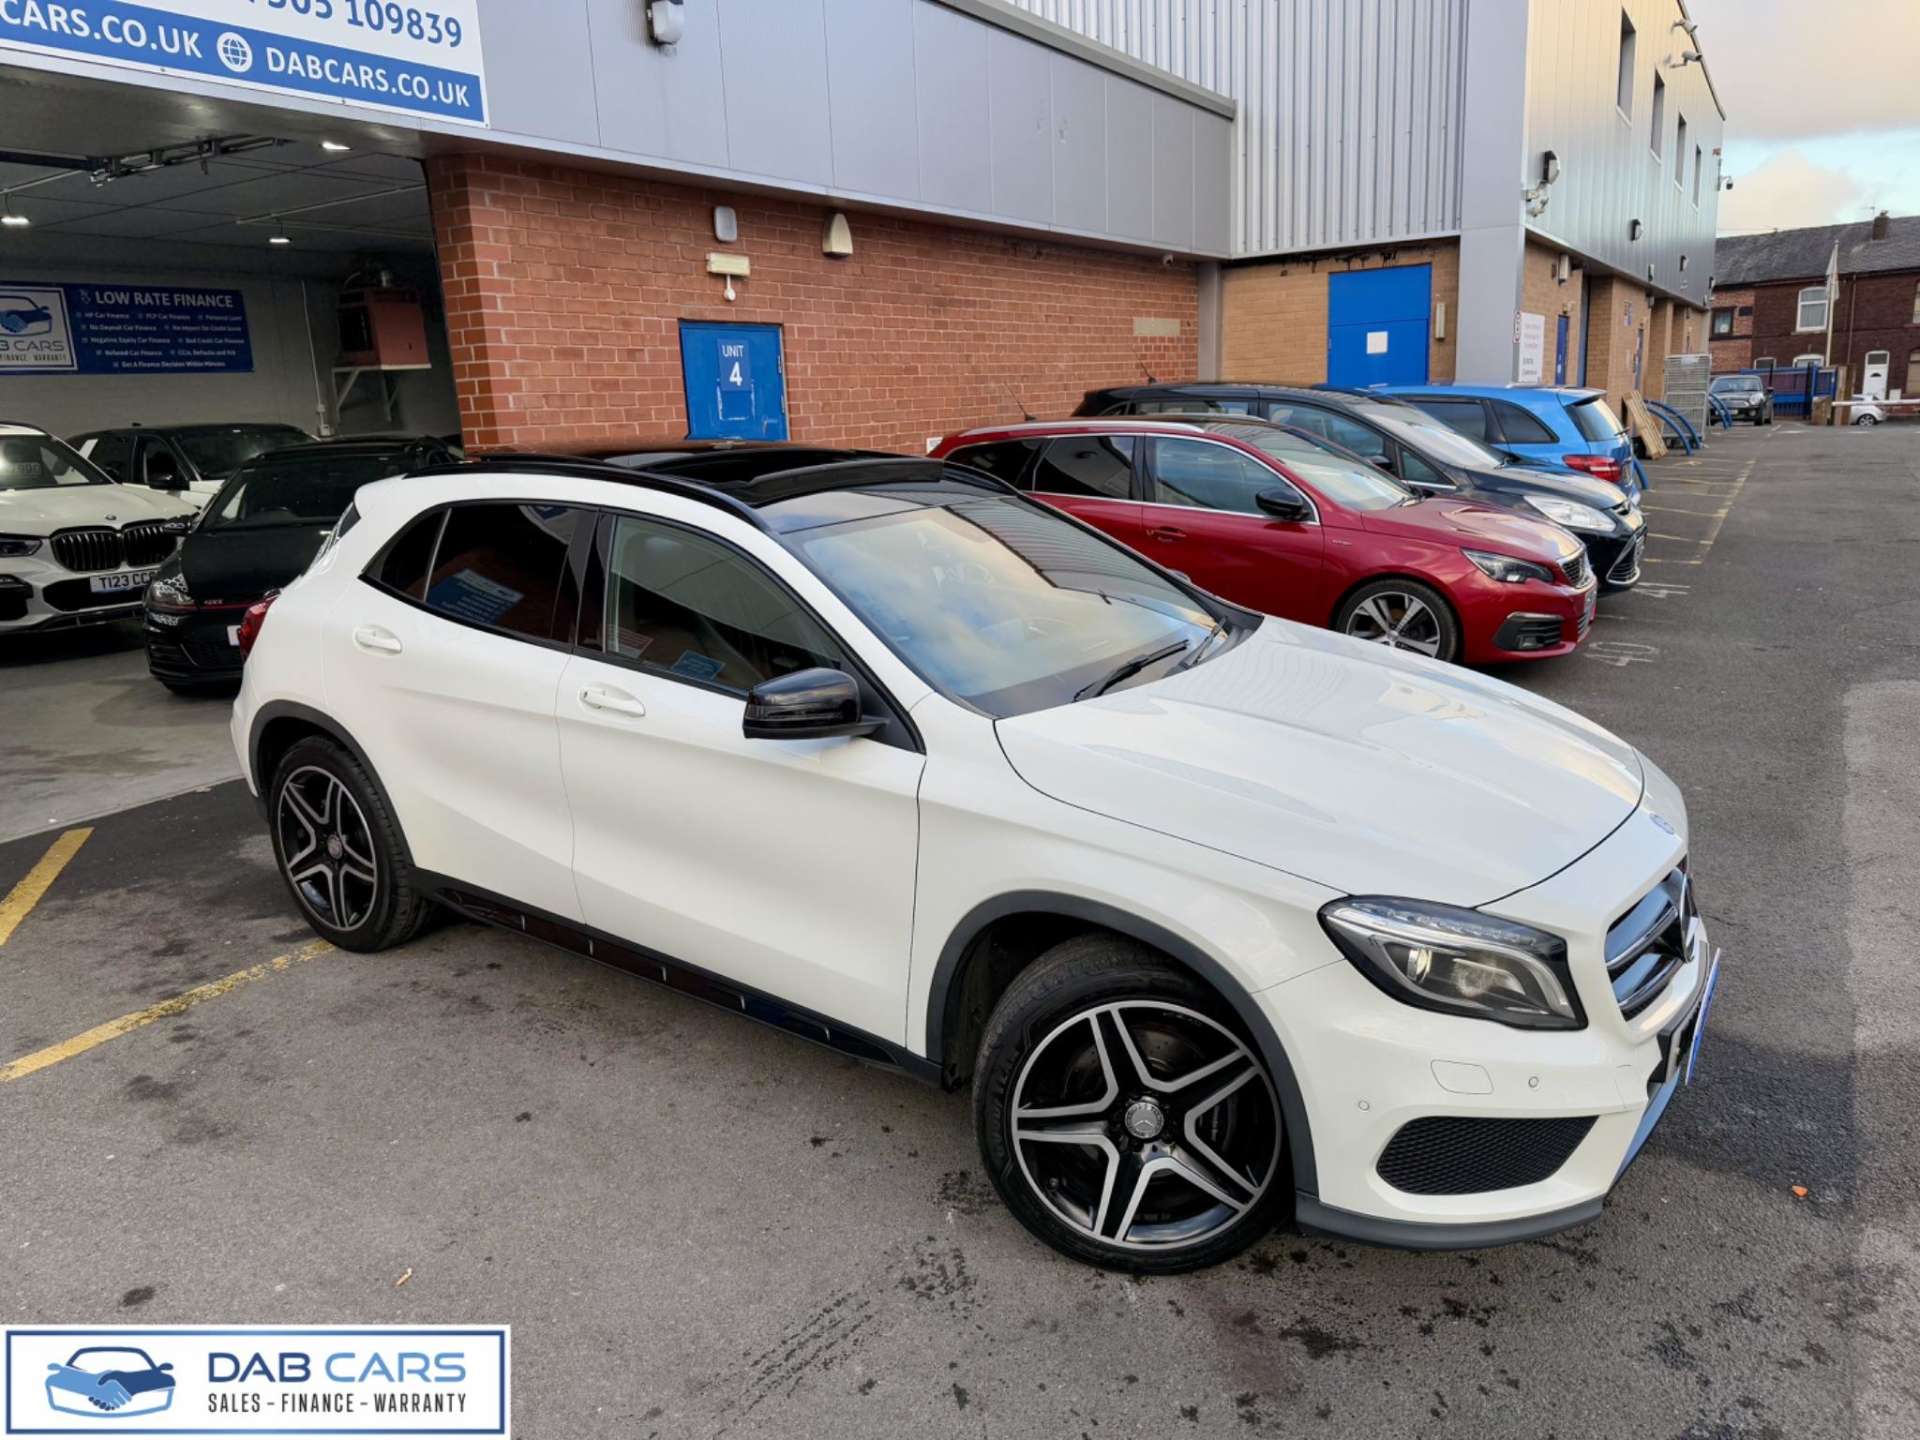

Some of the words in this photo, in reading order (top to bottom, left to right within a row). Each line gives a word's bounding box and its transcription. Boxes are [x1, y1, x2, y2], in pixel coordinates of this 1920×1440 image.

[346, 0, 462, 48] 109839
[266, 46, 471, 108] DABCARS.CO.UK
[95, 291, 129, 305] LOW
[134, 292, 171, 306] RATE
[173, 293, 233, 308] FINANCE
[14, 340, 65, 352] CARS
[721, 344, 745, 358] UNIT
[729, 361, 743, 387] 4
[98, 574, 129, 589] T123
